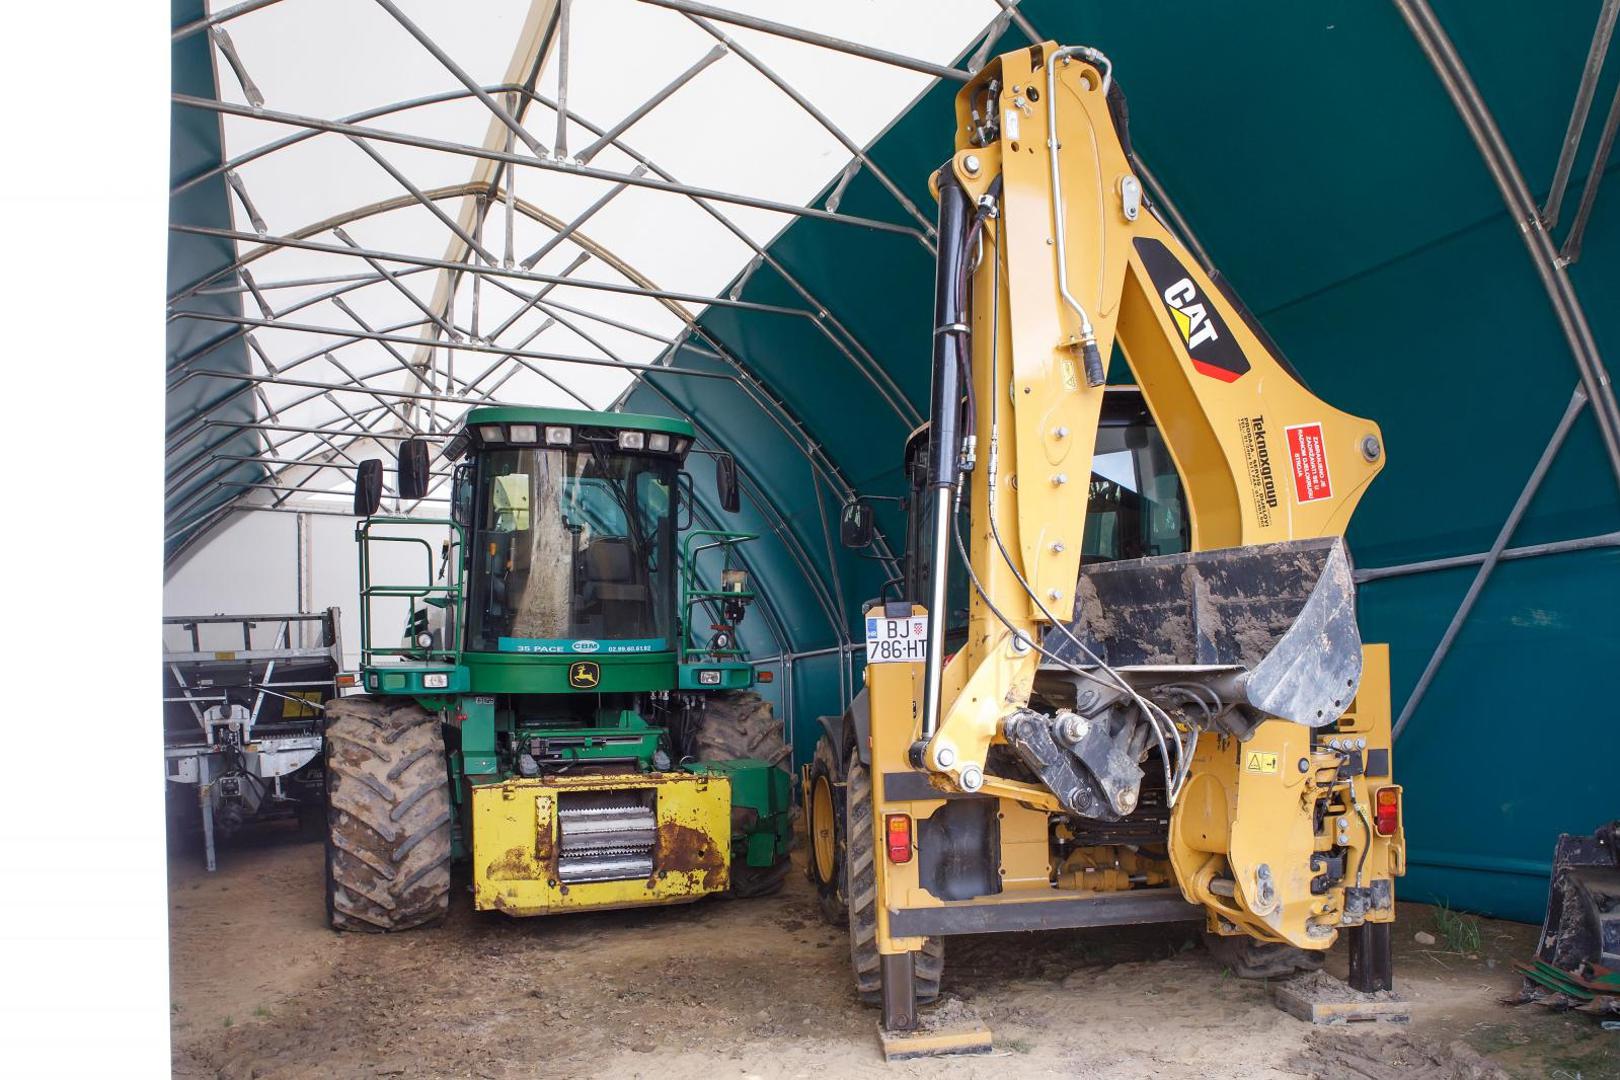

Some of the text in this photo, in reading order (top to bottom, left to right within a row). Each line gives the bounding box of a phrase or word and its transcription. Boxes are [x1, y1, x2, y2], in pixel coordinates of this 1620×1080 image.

[1164, 278, 1218, 350] CAT
[1297, 429, 1306, 457] RADNOM
[1244, 418, 1254, 452] PRODAJA
[1252, 460, 1261, 486] SERVIS
[1259, 493, 1269, 527] DIJELOVI
[1251, 416, 1277, 508] Teknoxgroup
[1294, 453, 1303, 477] STROJA
[1312, 436, 1326, 488] ZABRANJENO JE
[1312, 475, 1318, 484] SE
[887, 620, 909, 638] BJ
[870, 640, 927, 659] 786-HT
